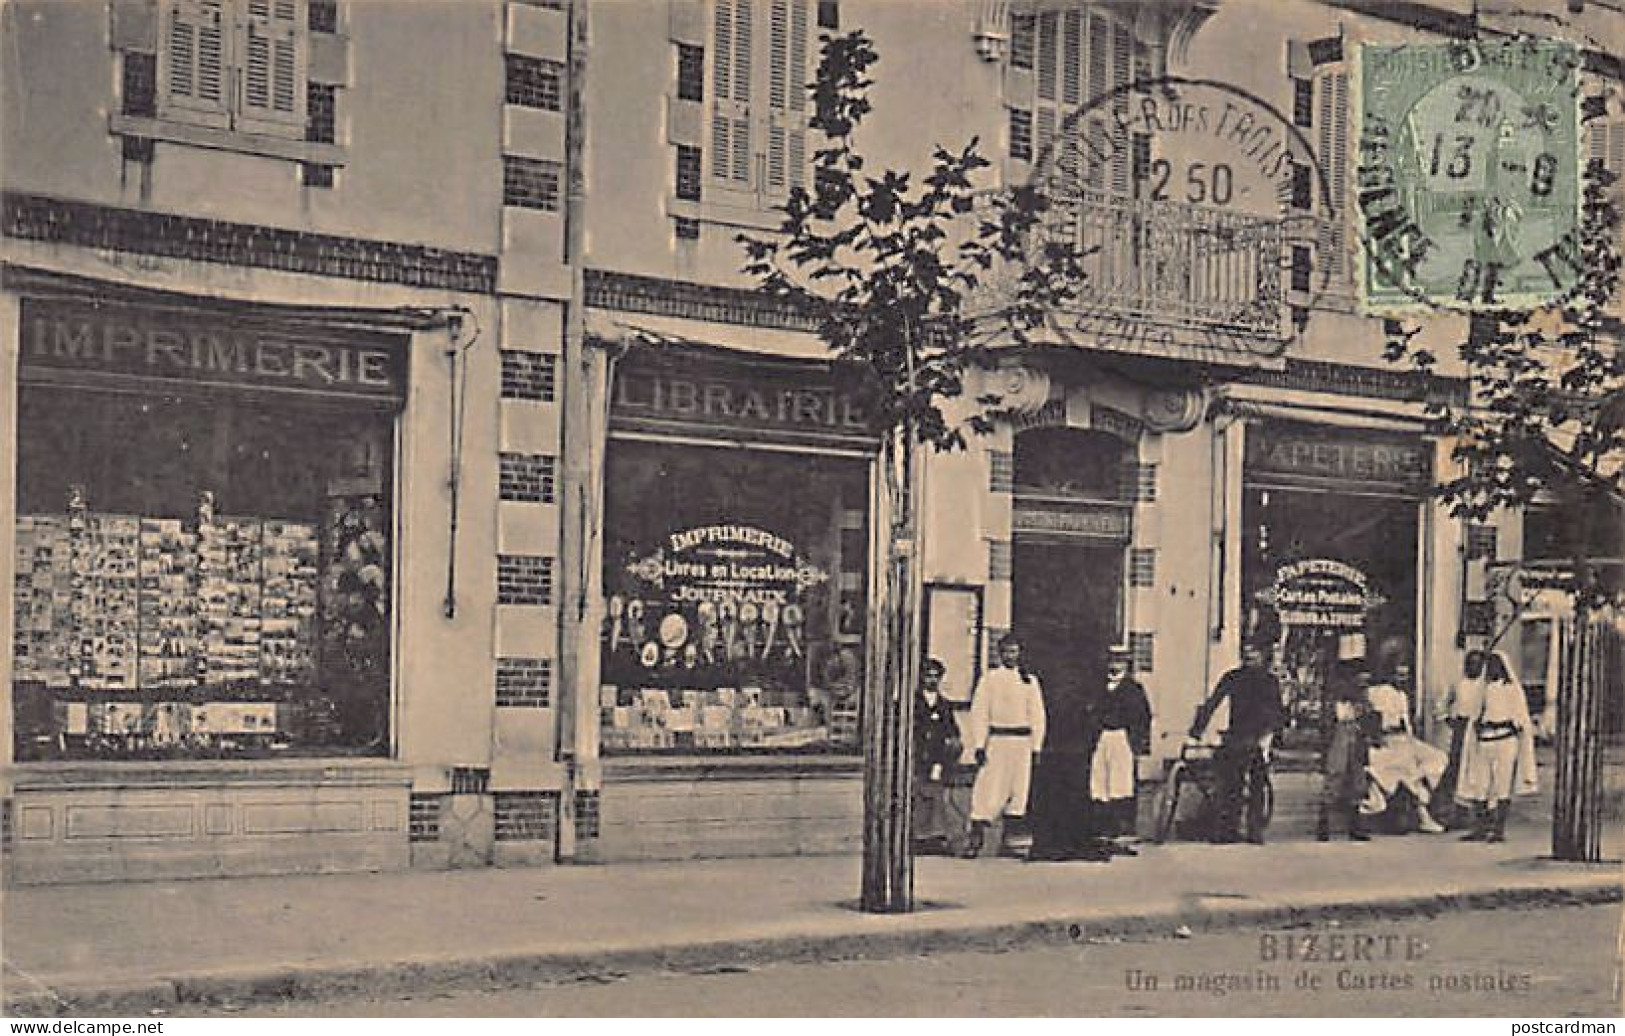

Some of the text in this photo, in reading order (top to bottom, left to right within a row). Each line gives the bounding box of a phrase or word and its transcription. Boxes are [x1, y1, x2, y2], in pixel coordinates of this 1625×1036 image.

[32, 316, 392, 386] IMPRIMERIE
[669, 524, 795, 559] IMPRIMERIE
[730, 561, 794, 581] Location
[670, 584, 788, 606] JOURNAUX
